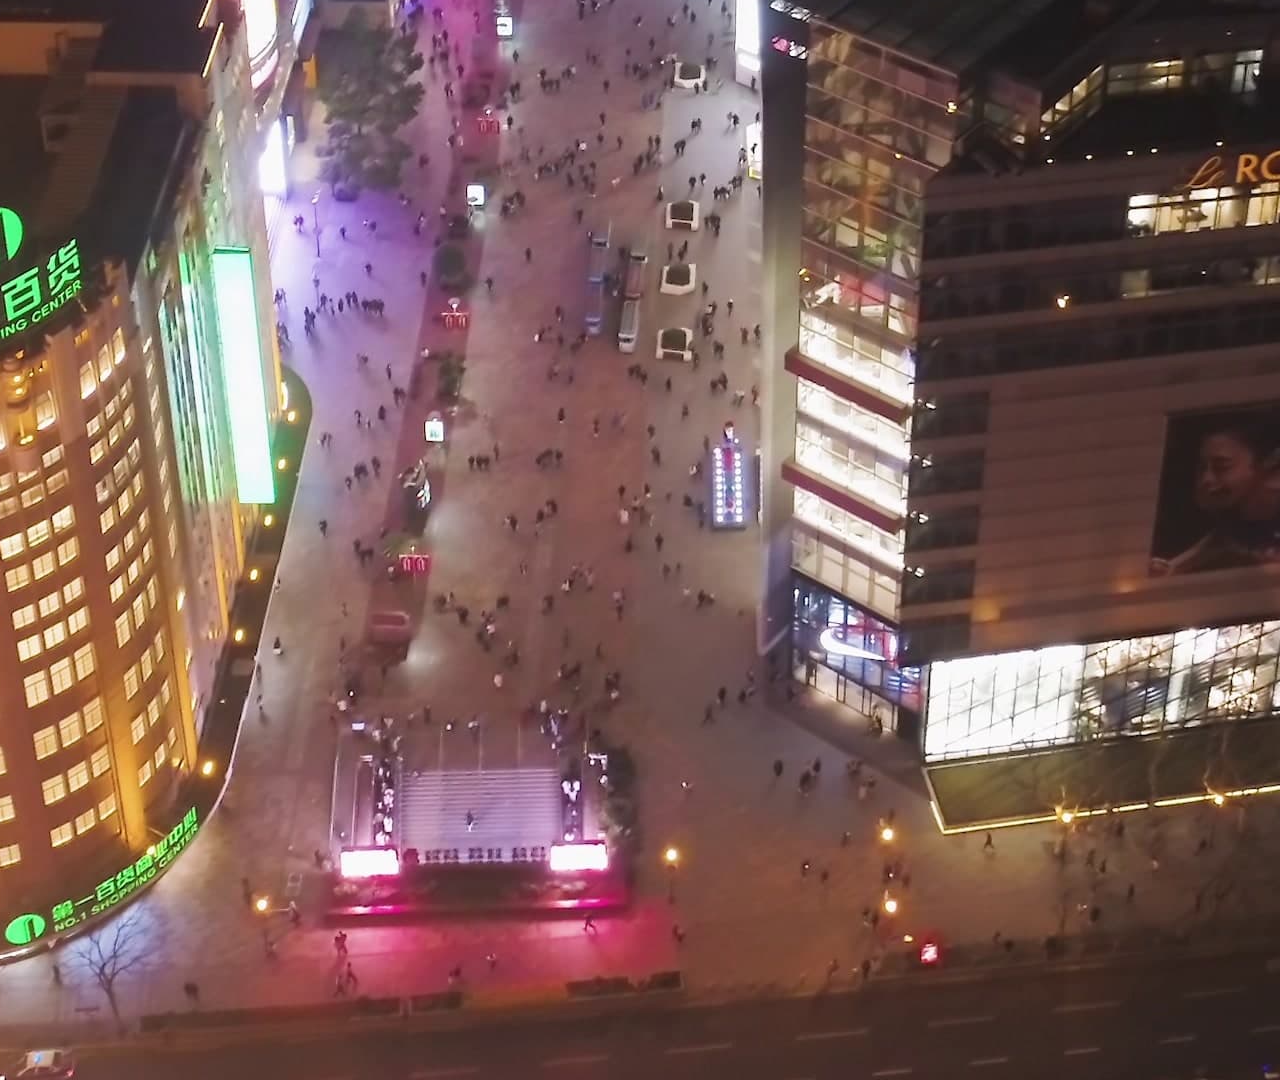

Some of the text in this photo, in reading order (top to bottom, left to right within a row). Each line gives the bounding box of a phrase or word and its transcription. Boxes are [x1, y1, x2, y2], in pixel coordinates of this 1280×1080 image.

[31, 280, 82, 324] CENTER
[52, 806, 197, 921] 第一百货商业中心
[54, 823, 199, 933] NO.1 SHOPPING CENTER
